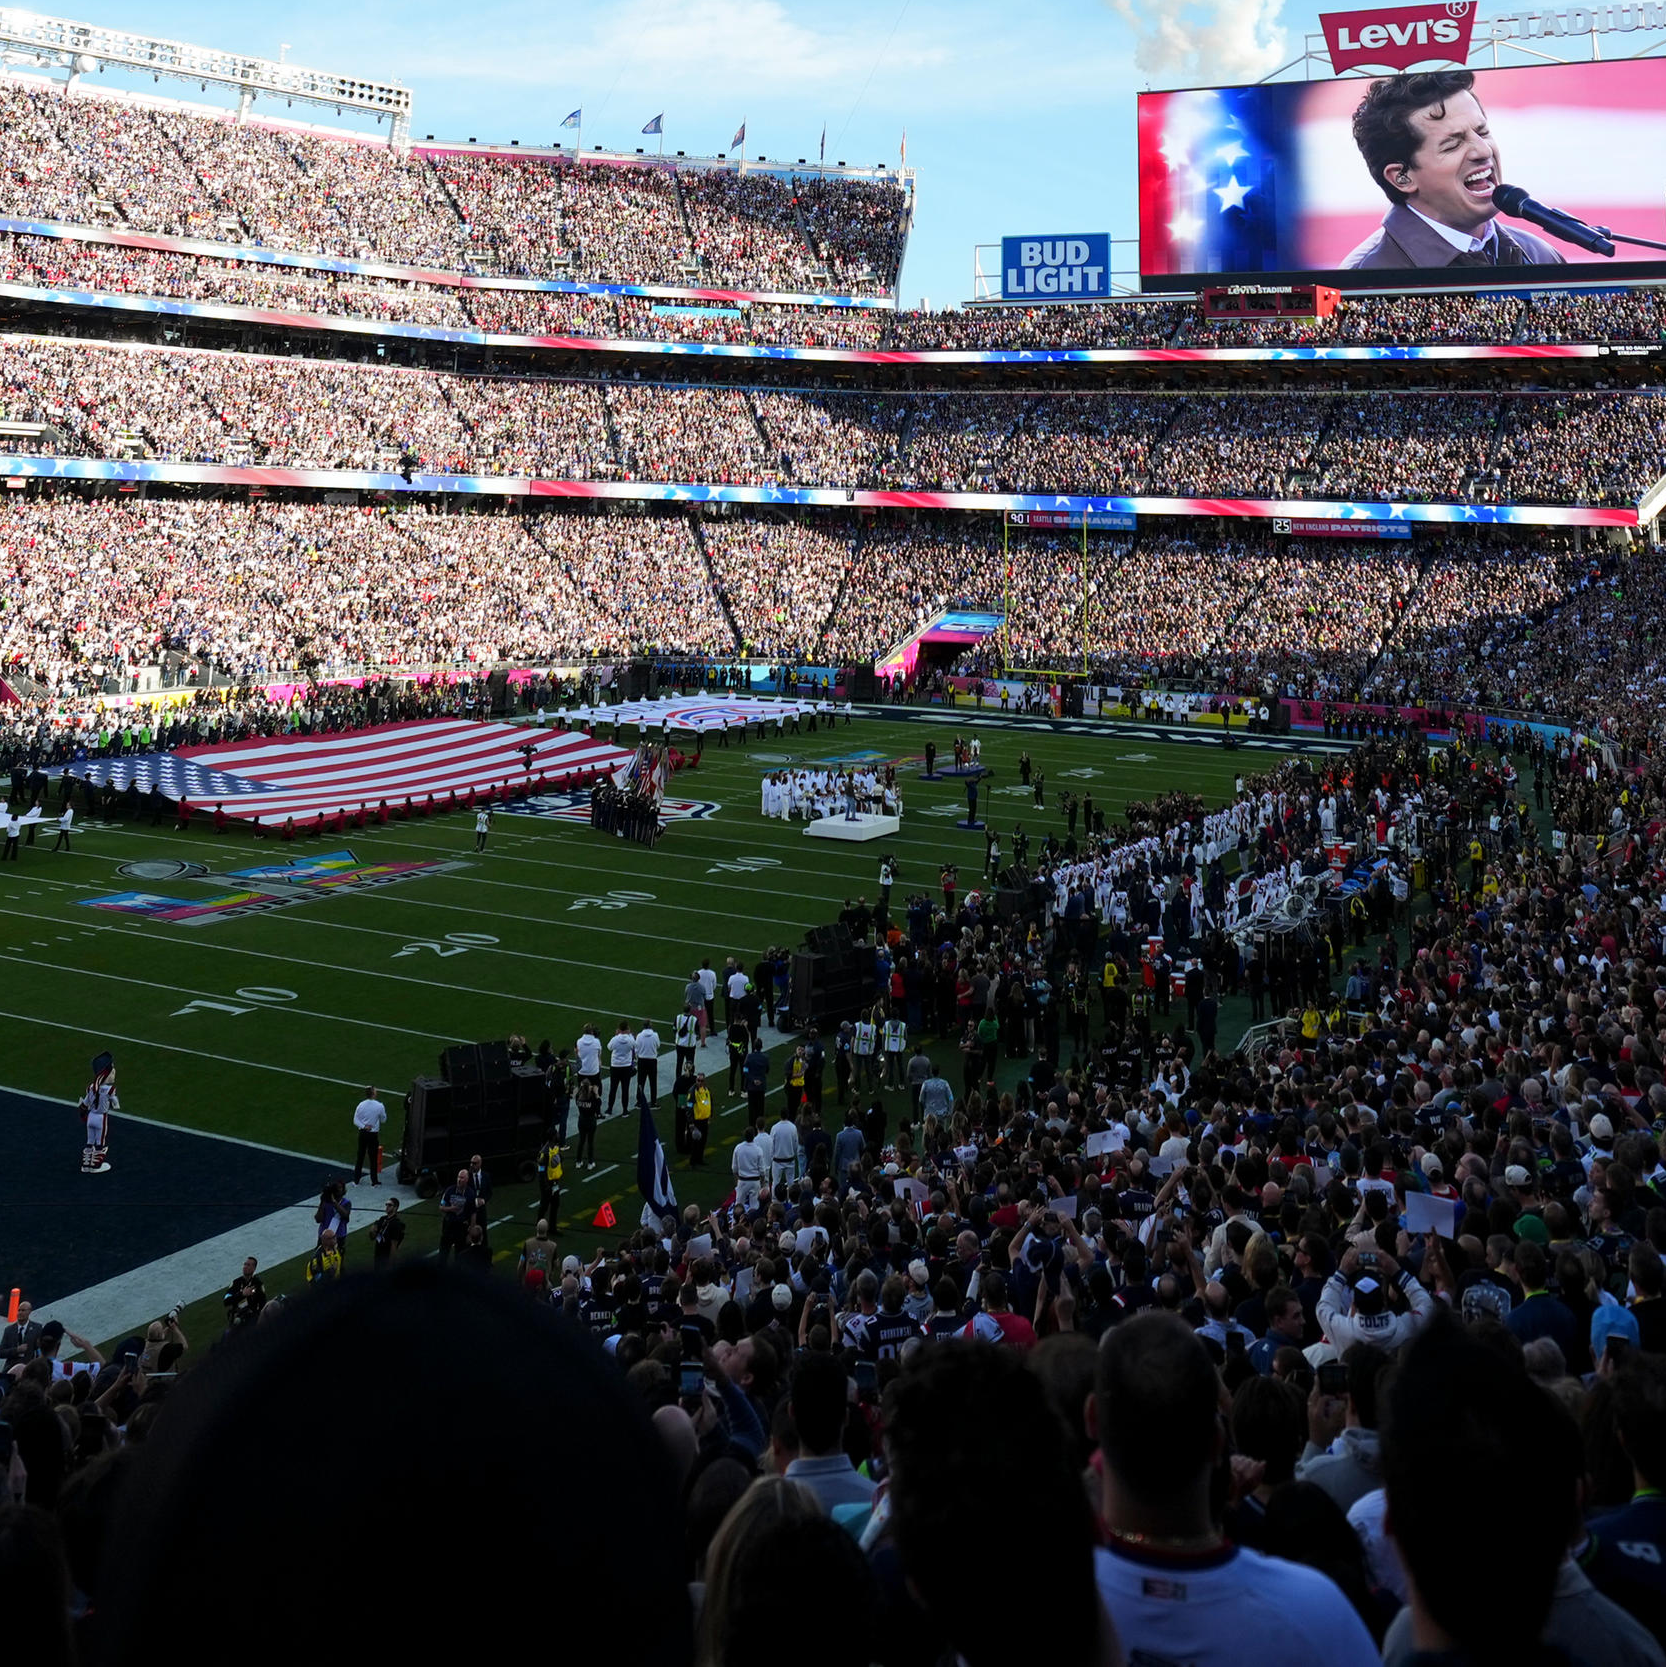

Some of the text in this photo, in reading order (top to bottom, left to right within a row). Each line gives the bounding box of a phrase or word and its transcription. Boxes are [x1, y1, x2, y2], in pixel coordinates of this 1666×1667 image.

[1020, 240, 1090, 267] BUD
[1007, 266, 1104, 294] LIGHT
[1257, 286, 1292, 294] STADIUM
[1033, 515, 1133, 526] SEATTLE SEAHAWKS
[1275, 521, 1290, 531] 25
[1292, 523, 1410, 533] NEW ENGLAND PATRIOTS
[705, 855, 784, 875] 40
[215, 867, 442, 919] SUPER BOWL
[567, 890, 657, 912] 30
[390, 932, 501, 959] 20
[169, 986, 298, 1018] 10
[1134, 1202, 1153, 1213] BRADY
[1359, 1314, 1390, 1328] COLTS
